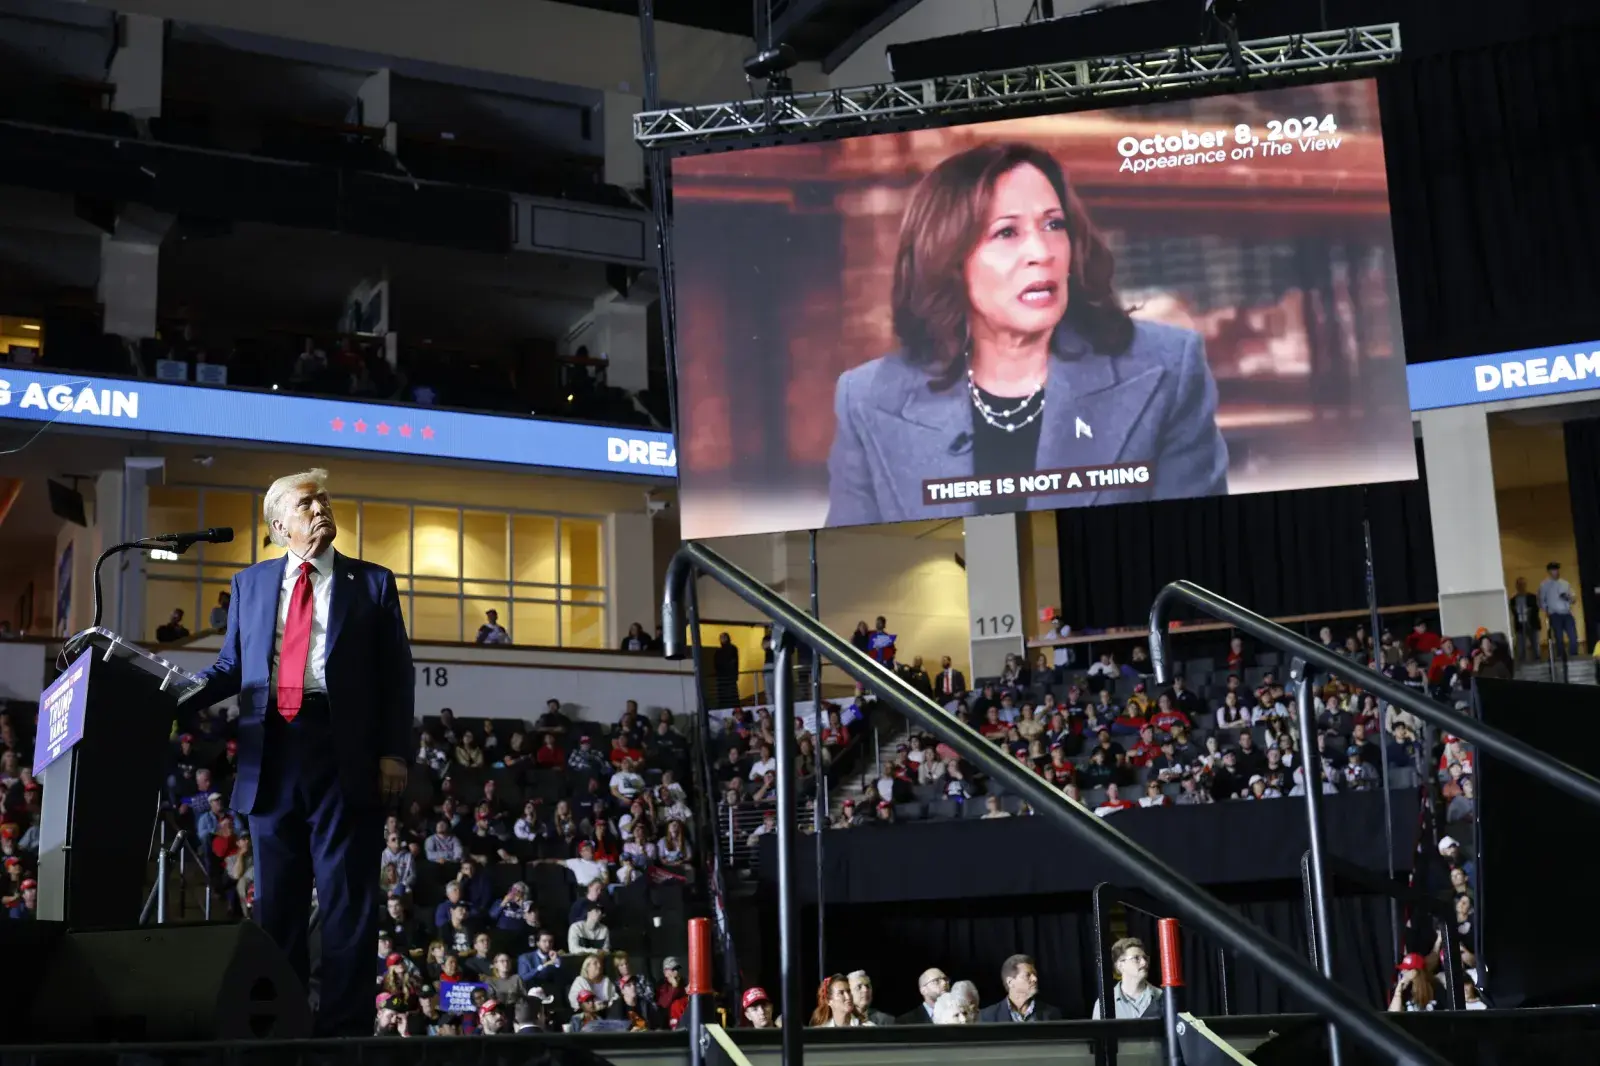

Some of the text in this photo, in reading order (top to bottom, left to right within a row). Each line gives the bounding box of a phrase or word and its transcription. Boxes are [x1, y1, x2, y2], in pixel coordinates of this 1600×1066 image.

[1117, 113, 1338, 157] October 8, 2024
[1119, 135, 1342, 173] Appearance on The View
[1475, 351, 1600, 392] DREAM
[20, 382, 138, 418] AGAIN
[927, 467, 1150, 500] THERE IS NOT A THING
[976, 614, 1015, 636] 119
[49, 688, 73, 726] TRUMP
